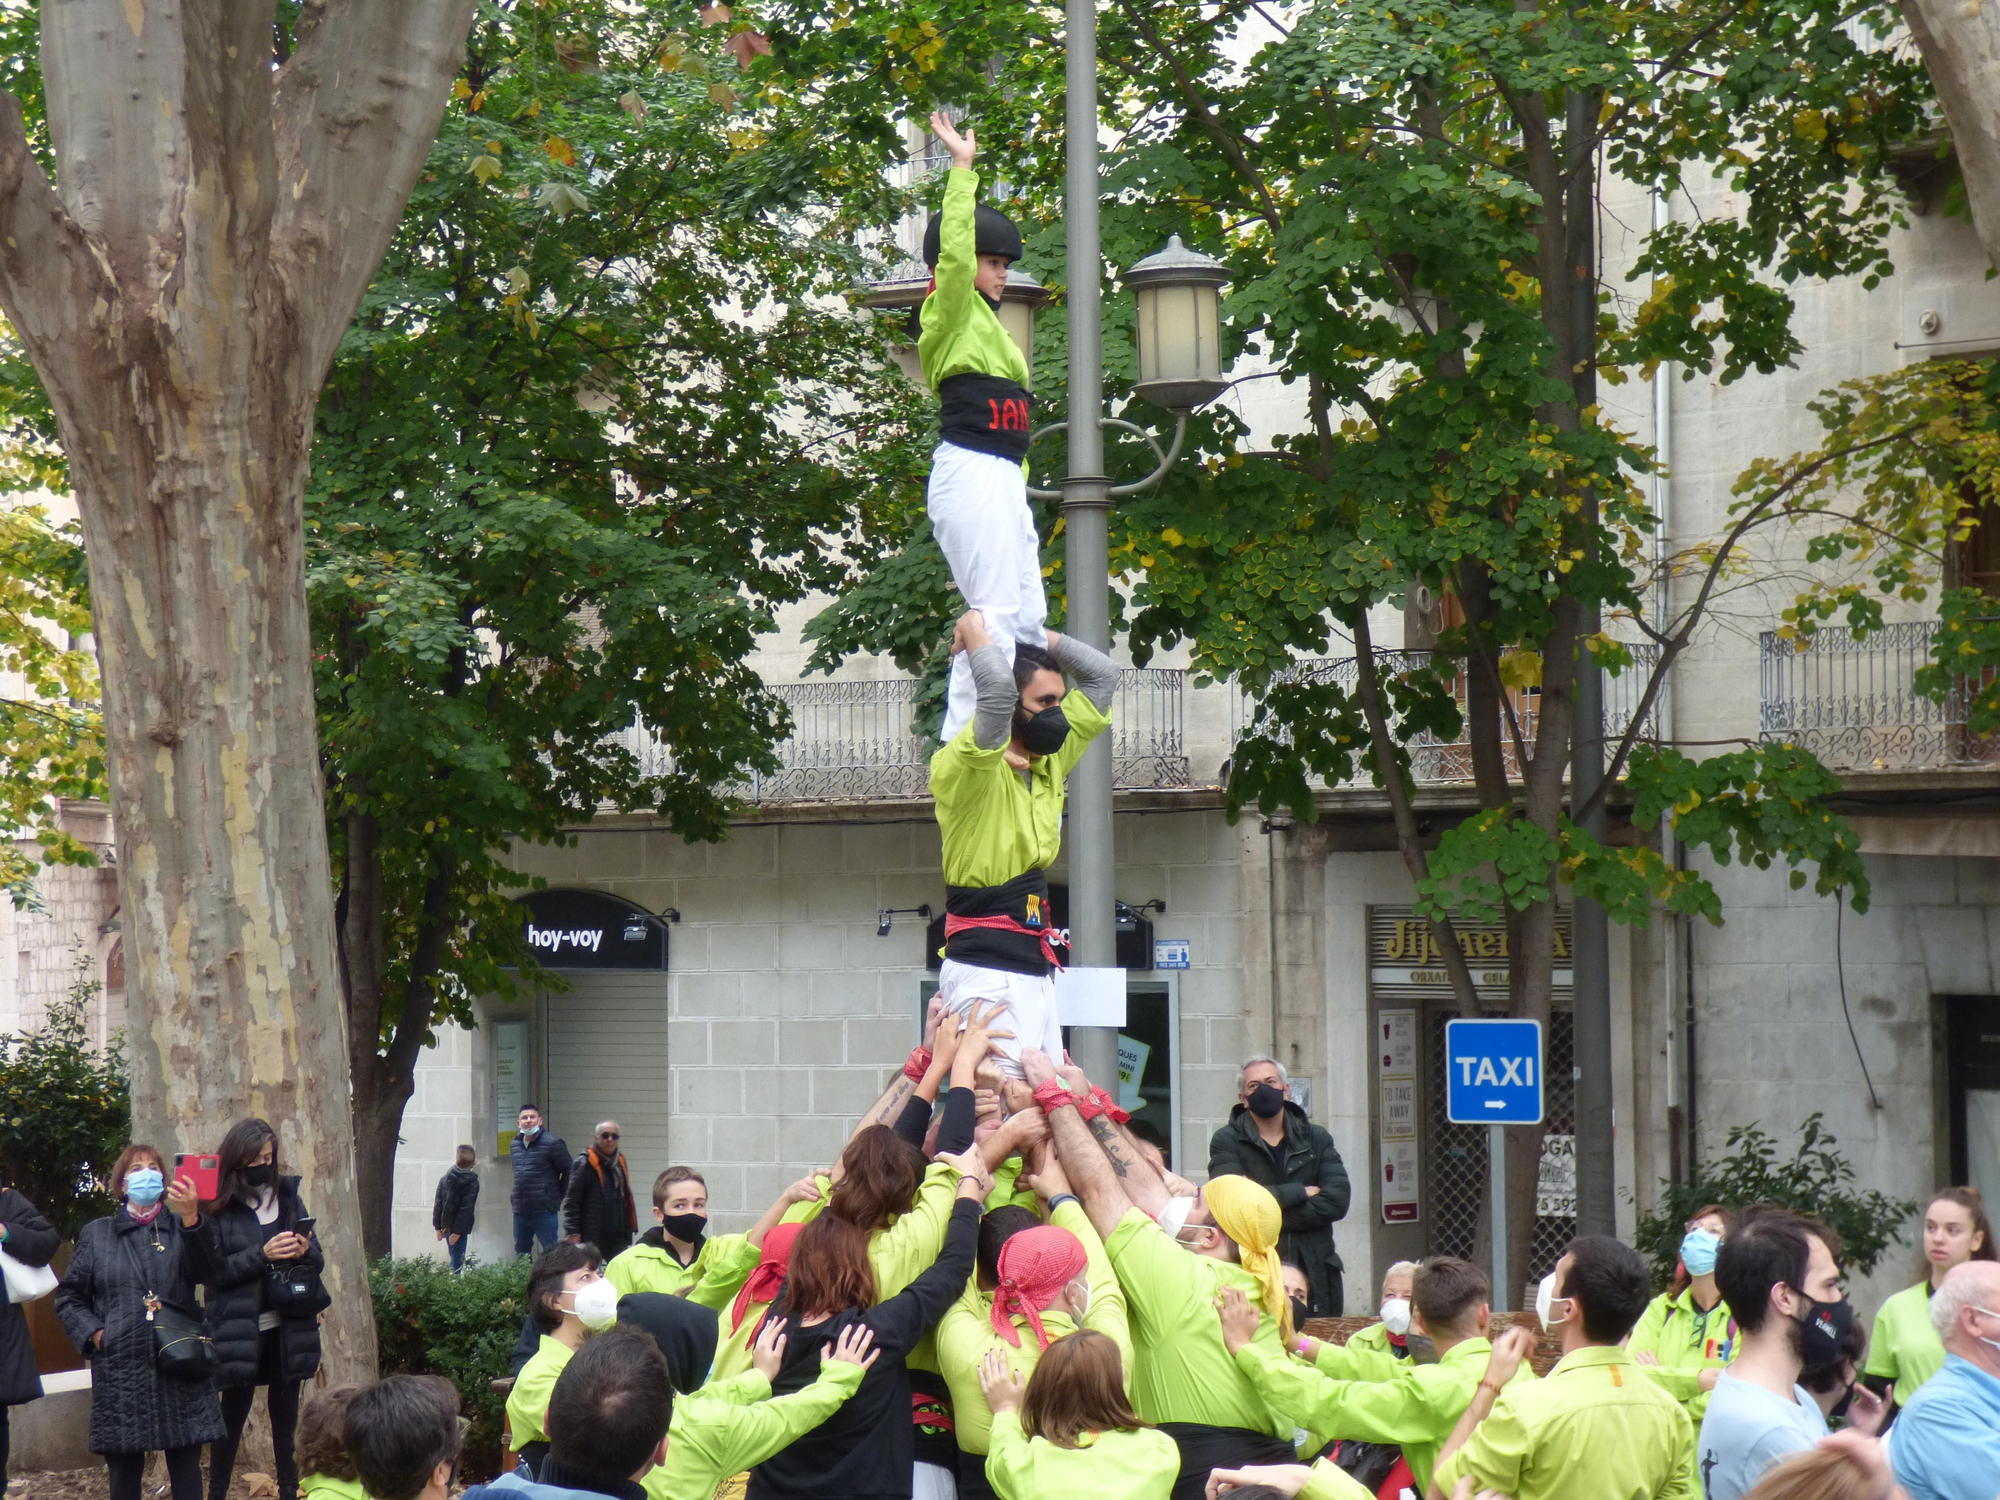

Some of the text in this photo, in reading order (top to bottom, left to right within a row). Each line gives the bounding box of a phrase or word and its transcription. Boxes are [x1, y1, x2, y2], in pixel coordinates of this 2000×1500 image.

[528, 924, 603, 952] hoy-voy
[1455, 1057, 1533, 1087] TAXI
[1384, 1086, 1411, 1101] TO TAKE
[1389, 1105, 1410, 1119] AWAY
